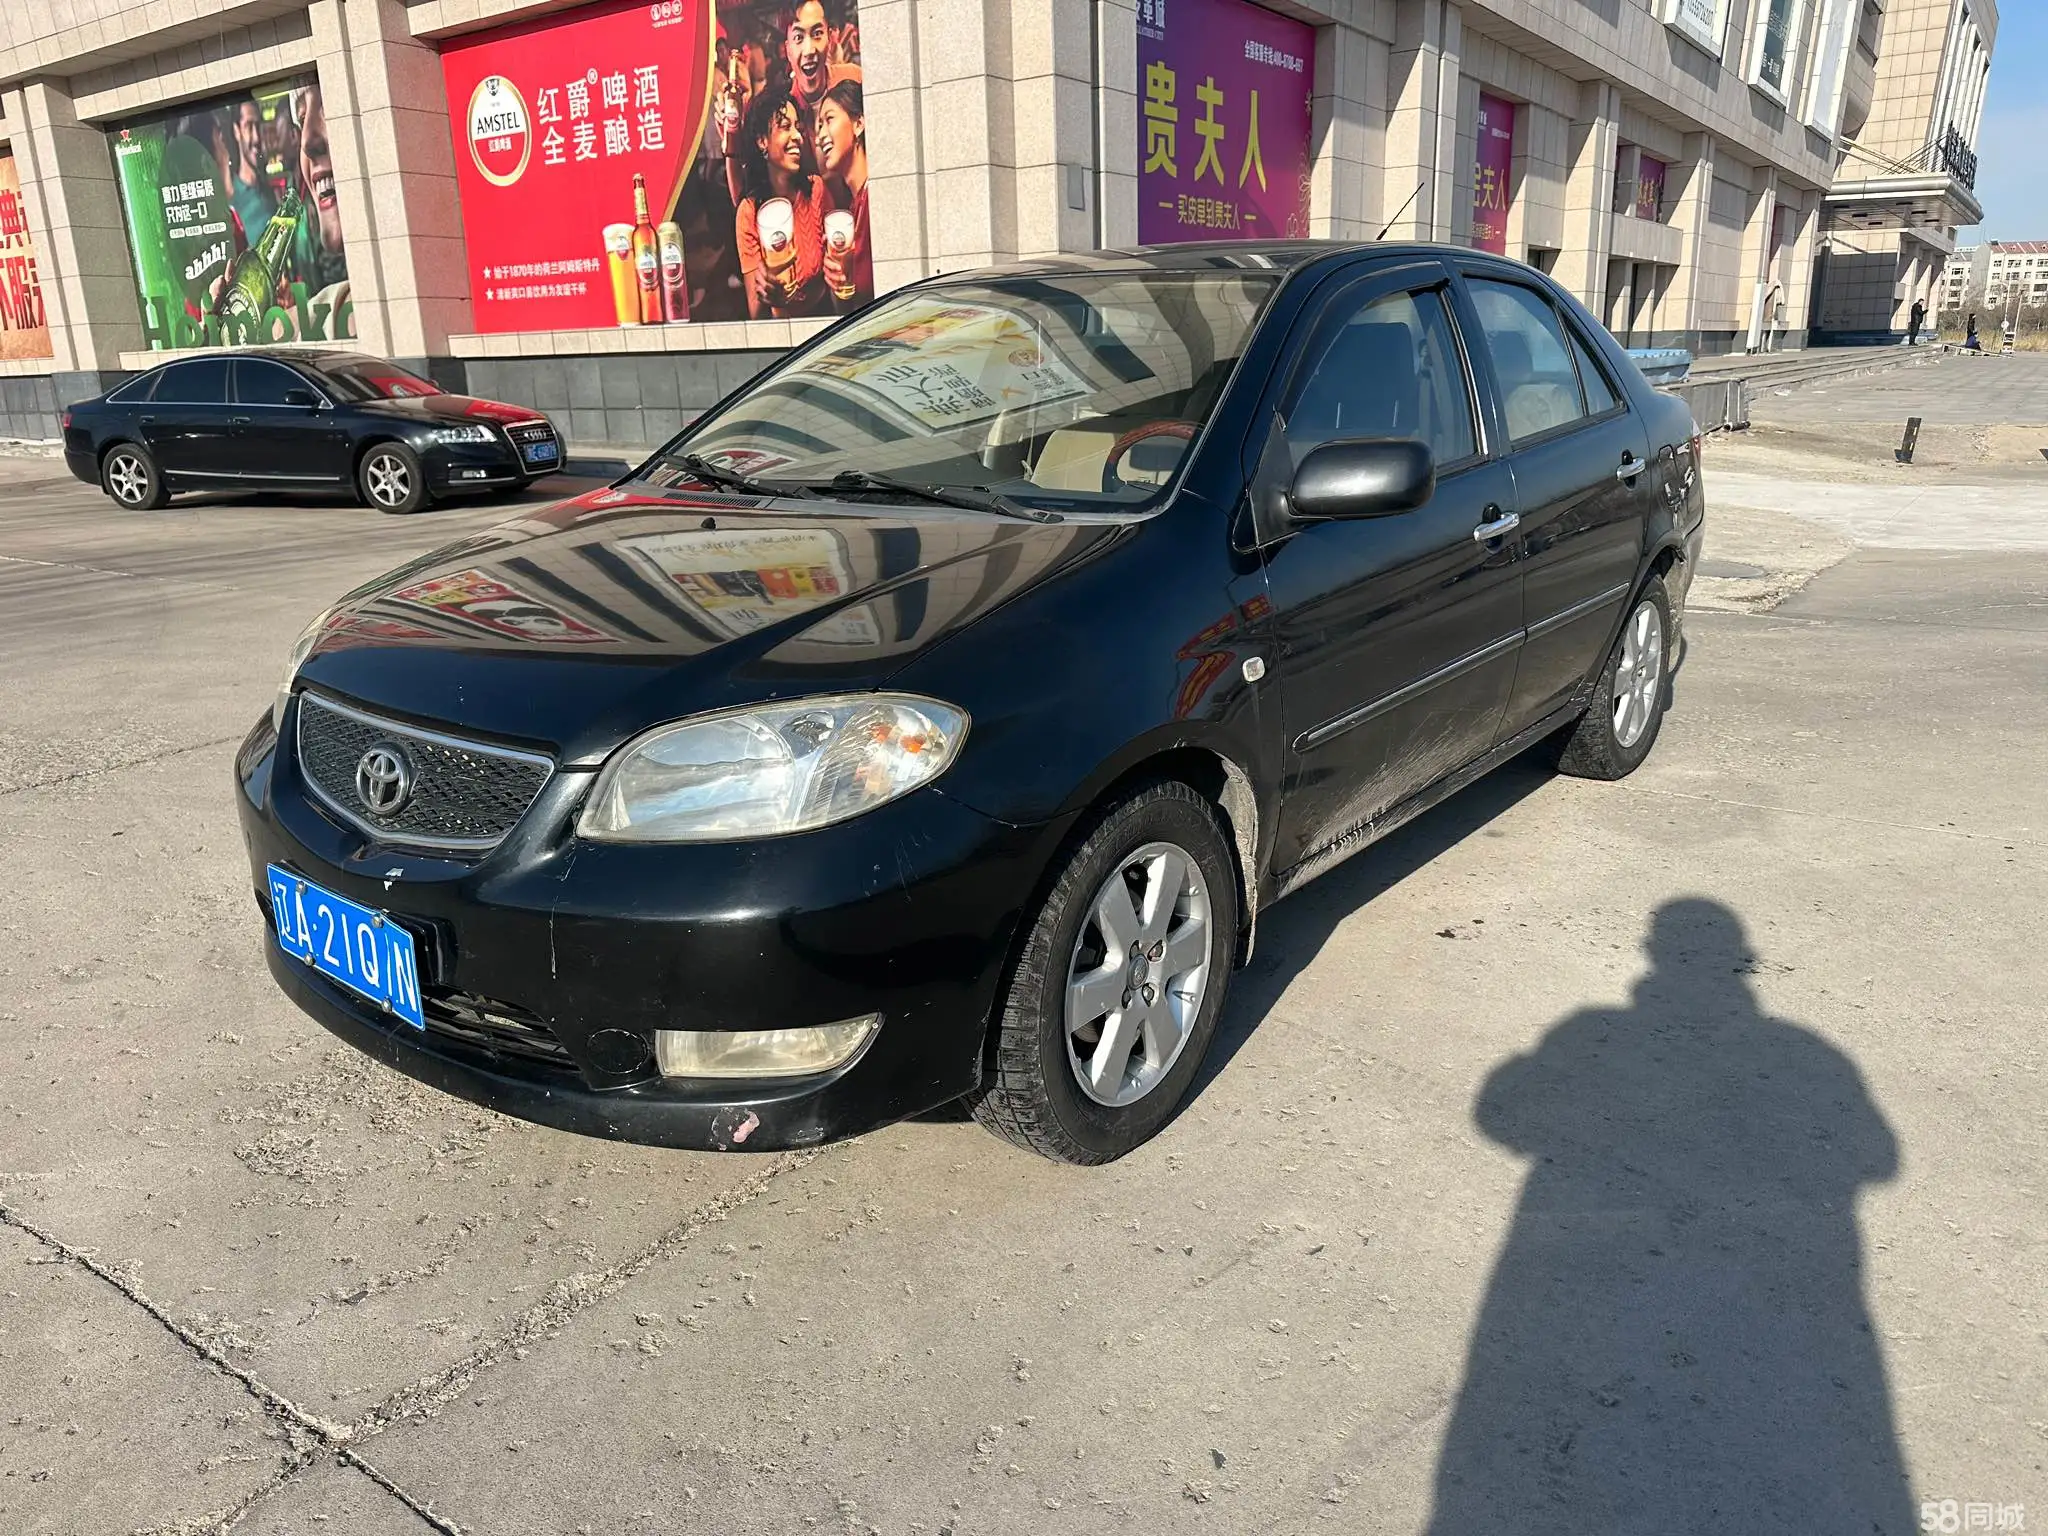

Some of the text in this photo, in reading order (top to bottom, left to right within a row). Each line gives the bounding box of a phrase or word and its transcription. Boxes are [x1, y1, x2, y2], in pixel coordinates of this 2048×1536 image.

[477, 112, 520, 134] AMSTEL
[542, 108, 665, 164] 全麦酿造
[1144, 60, 1266, 193] 贵夫人
